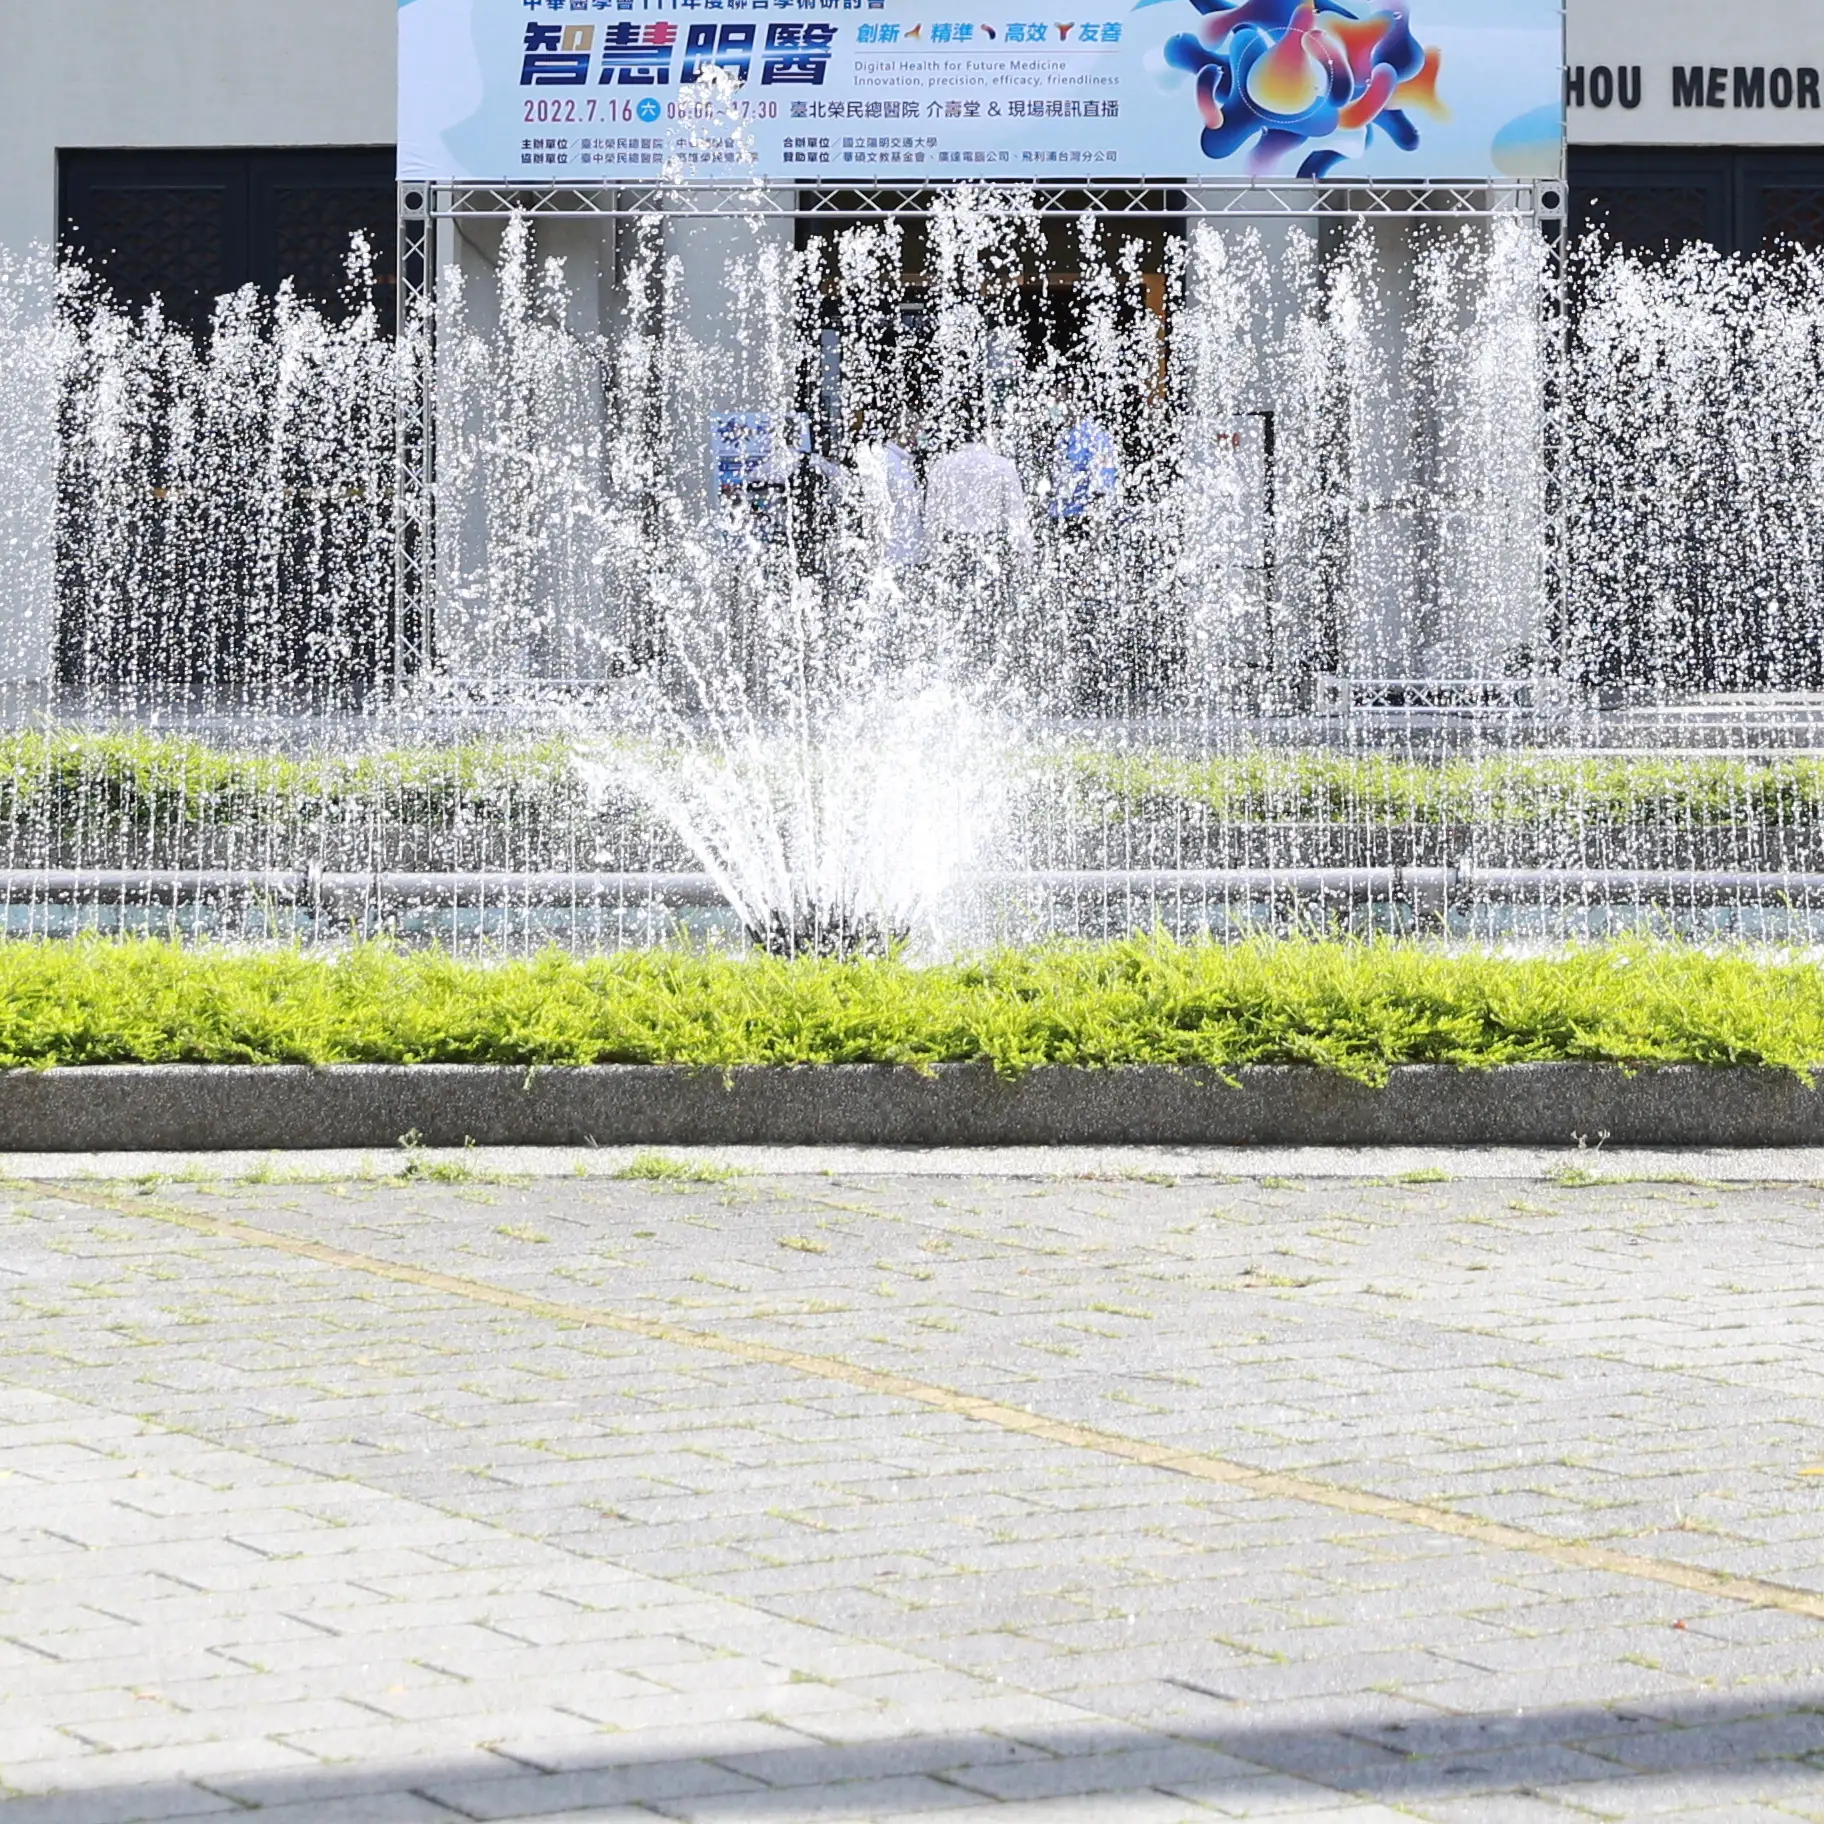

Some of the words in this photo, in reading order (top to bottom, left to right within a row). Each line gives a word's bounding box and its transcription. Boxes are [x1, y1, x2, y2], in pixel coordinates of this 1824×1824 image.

[856, 22, 901, 44] 創新
[930, 22, 974, 44] 精準
[1004, 22, 1049, 44] 高效
[1078, 21, 1123, 43] 友善
[519, 21, 839, 86] 智慧明醫
[854, 60, 896, 74] Digital
[900, 60, 940, 71] Health
[944, 60, 962, 71] for
[966, 60, 1006, 71] Future
[1010, 60, 1067, 71] Medicine
[854, 76, 924, 87] Innovation,
[928, 75, 988, 87] precision,
[992, 75, 1043, 87] efficacy,
[1047, 75, 1120, 86] friendliness
[523, 99, 633, 122] 2022.7.16
[789, 100, 920, 118] 臺北榮民總醫院
[926, 99, 980, 118] 介壽堂
[987, 100, 1002, 118] &
[1008, 99, 1119, 118] 現場視訊直播
